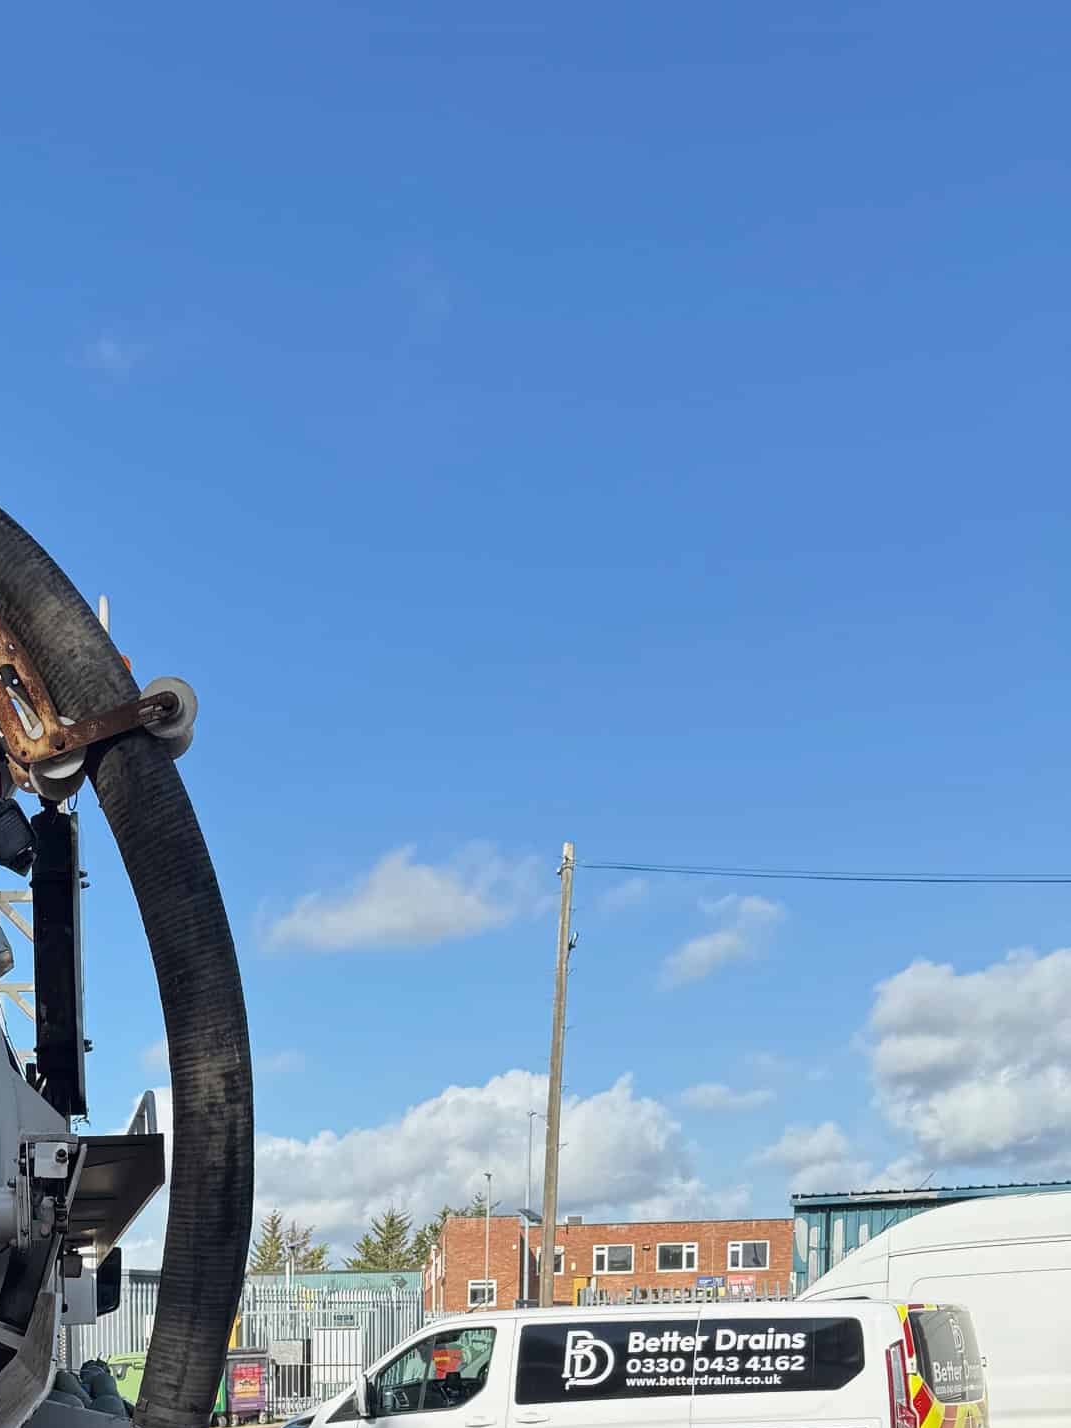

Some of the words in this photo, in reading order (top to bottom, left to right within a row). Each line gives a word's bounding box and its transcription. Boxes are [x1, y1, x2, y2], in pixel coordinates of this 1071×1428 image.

[628, 1331, 709, 1353] Better
[715, 1327, 807, 1351] Drains
[626, 1357, 686, 1374] 0330
[693, 1356, 740, 1372] 043
[745, 1355, 806, 1372] 4162
[932, 1361, 962, 1383] Better
[625, 1374, 783, 1387] www.betterdrains.co.uk
